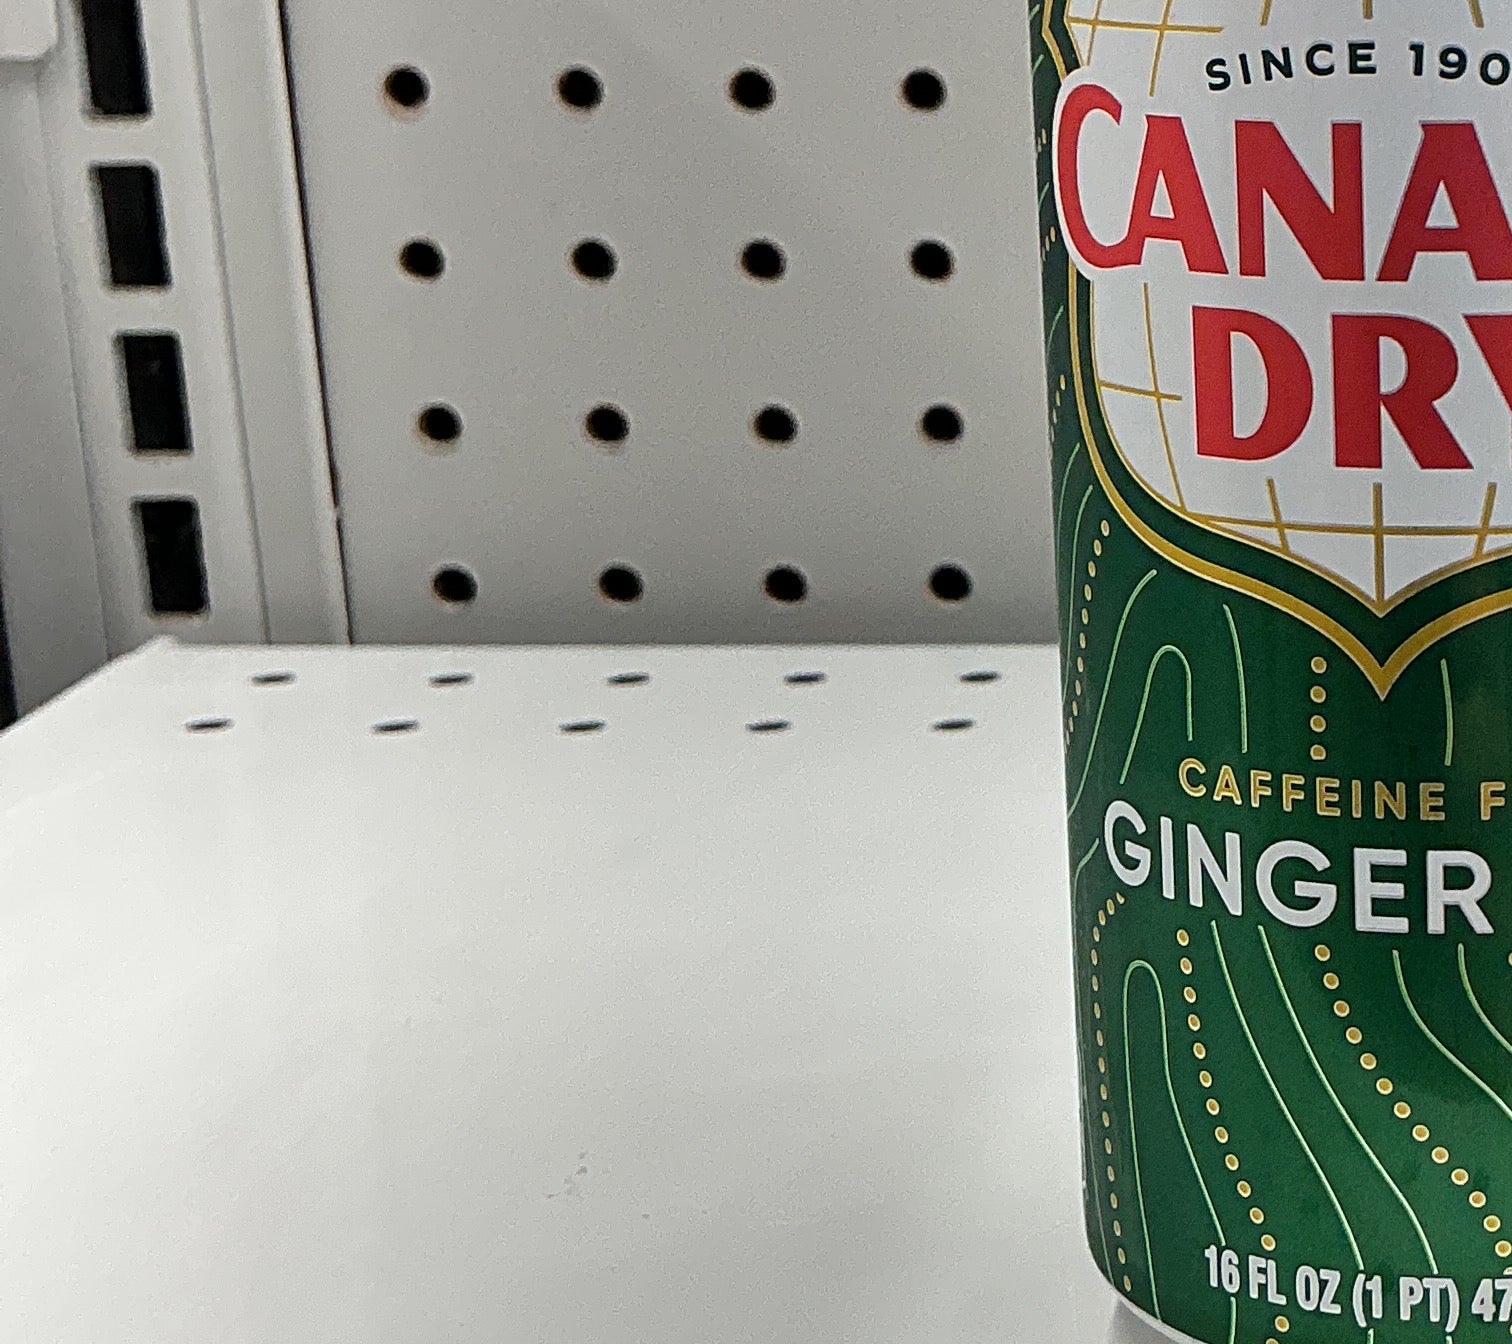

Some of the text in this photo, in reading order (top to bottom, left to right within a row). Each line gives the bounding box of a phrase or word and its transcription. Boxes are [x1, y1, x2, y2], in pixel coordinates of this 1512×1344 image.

[1204, 40, 1378, 92] SINCE
[1177, 757, 1446, 821] CAFFEINE
[1103, 798, 1495, 936] GINGER
[1203, 1243, 1241, 1295] 16
[1247, 1254, 1288, 1306] FL
[1295, 1264, 1342, 1315] OZ
[1352, 1272, 1384, 1328] (1
[1399, 1276, 1461, 1334] PT)
